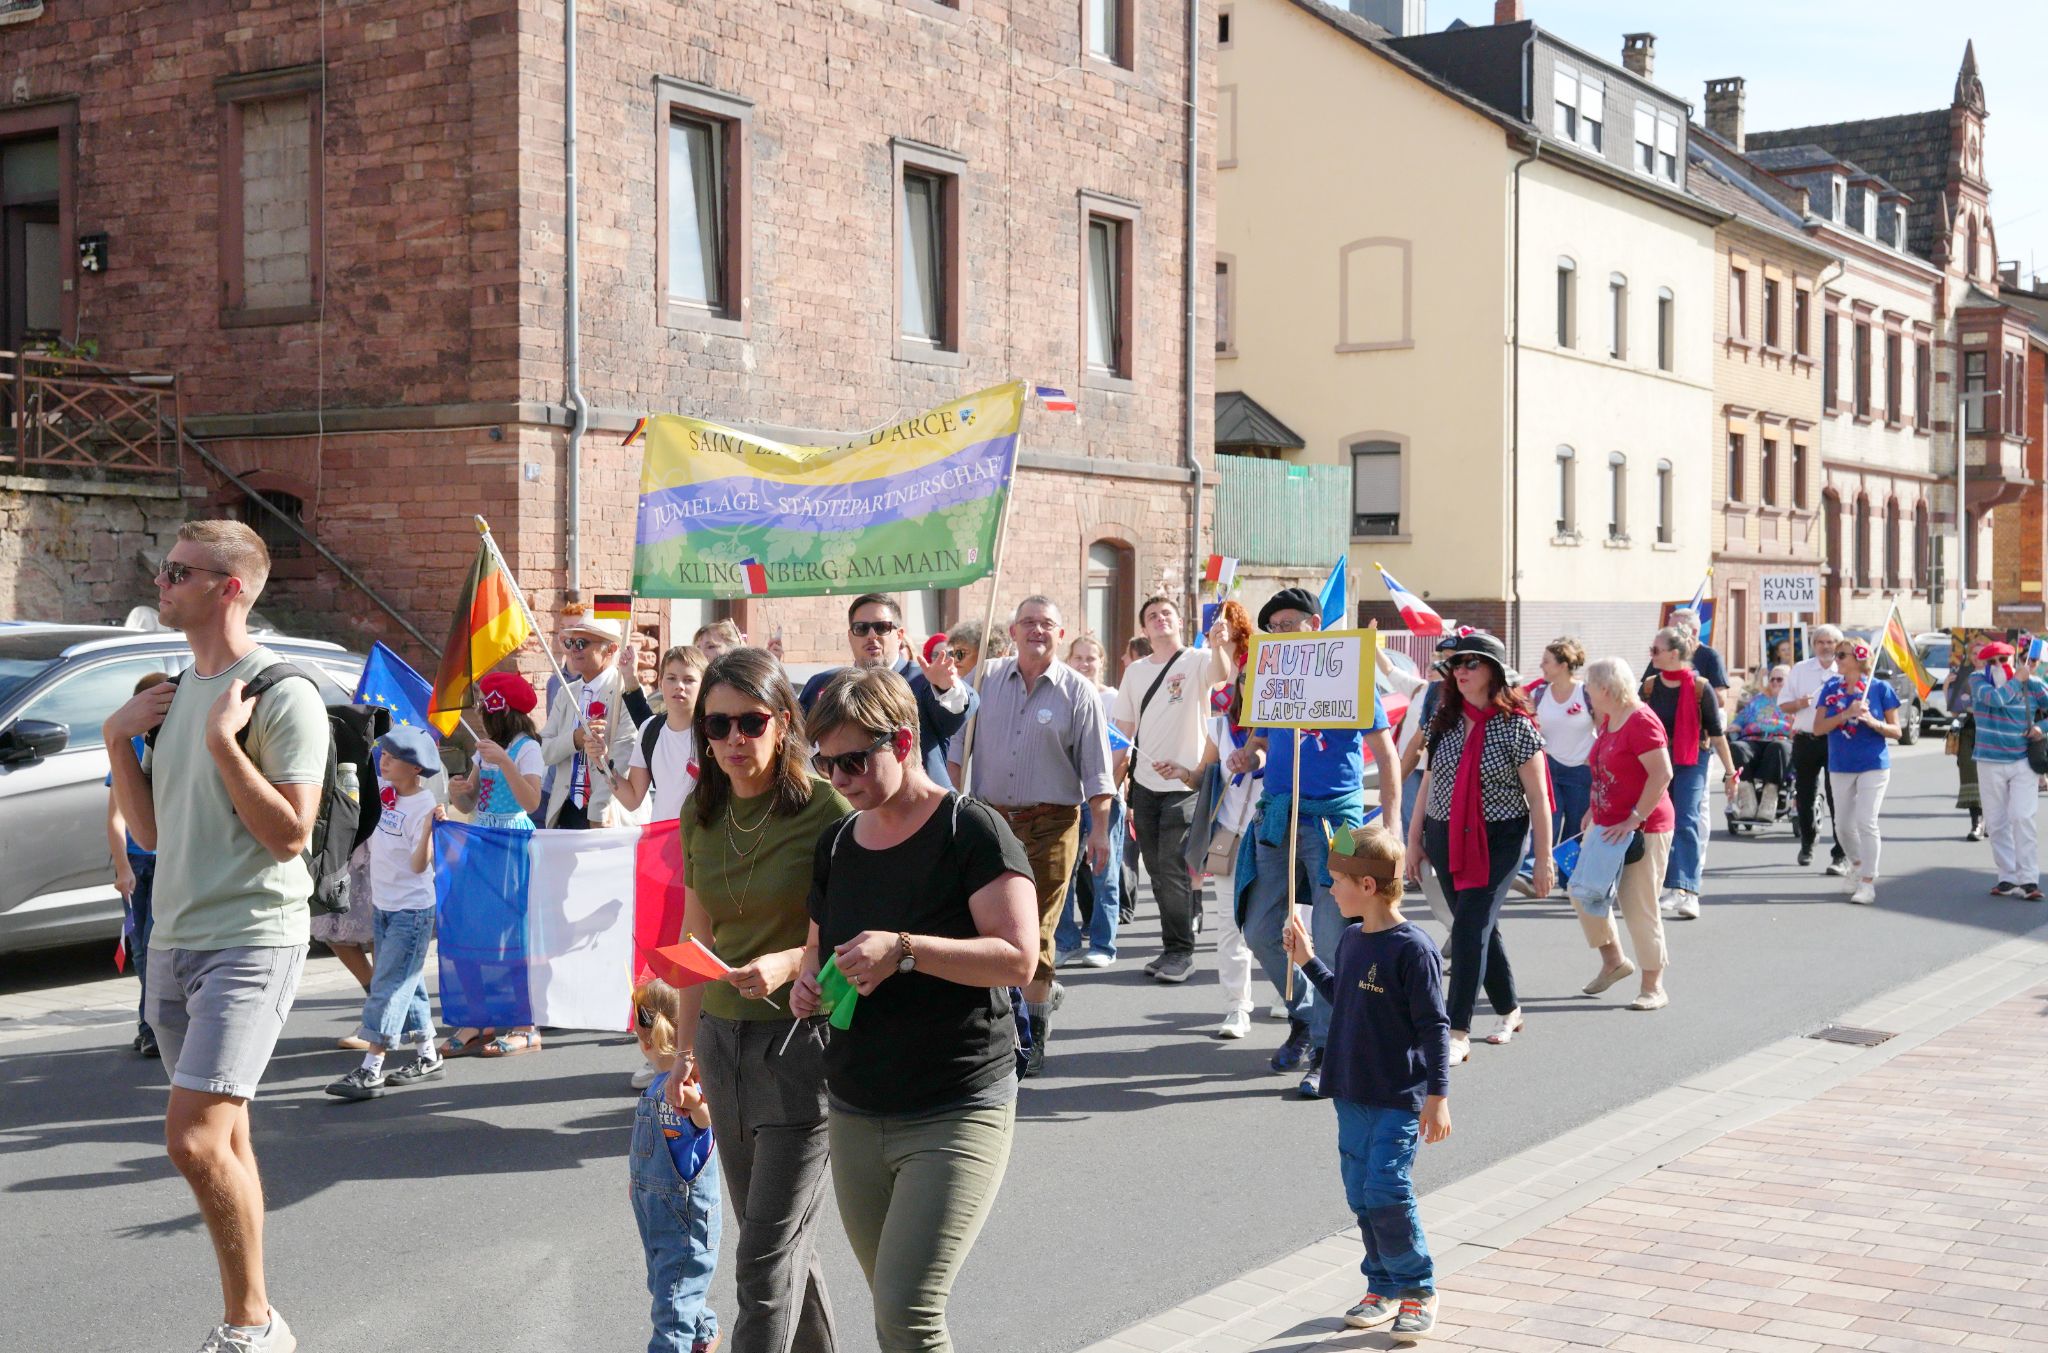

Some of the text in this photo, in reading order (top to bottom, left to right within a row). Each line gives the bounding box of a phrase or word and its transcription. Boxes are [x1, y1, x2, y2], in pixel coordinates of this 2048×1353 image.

[653, 492, 760, 530] JUMELAGE
[678, 549, 961, 584] KLINGNBERG AM MAIN
[1763, 577, 1815, 589] KUNST
[1764, 589, 1814, 601] RAUM
[1257, 641, 1344, 678] MUTIG
[1257, 700, 1356, 721] LAUT SEIN.
[1358, 980, 1384, 994] Matteo
